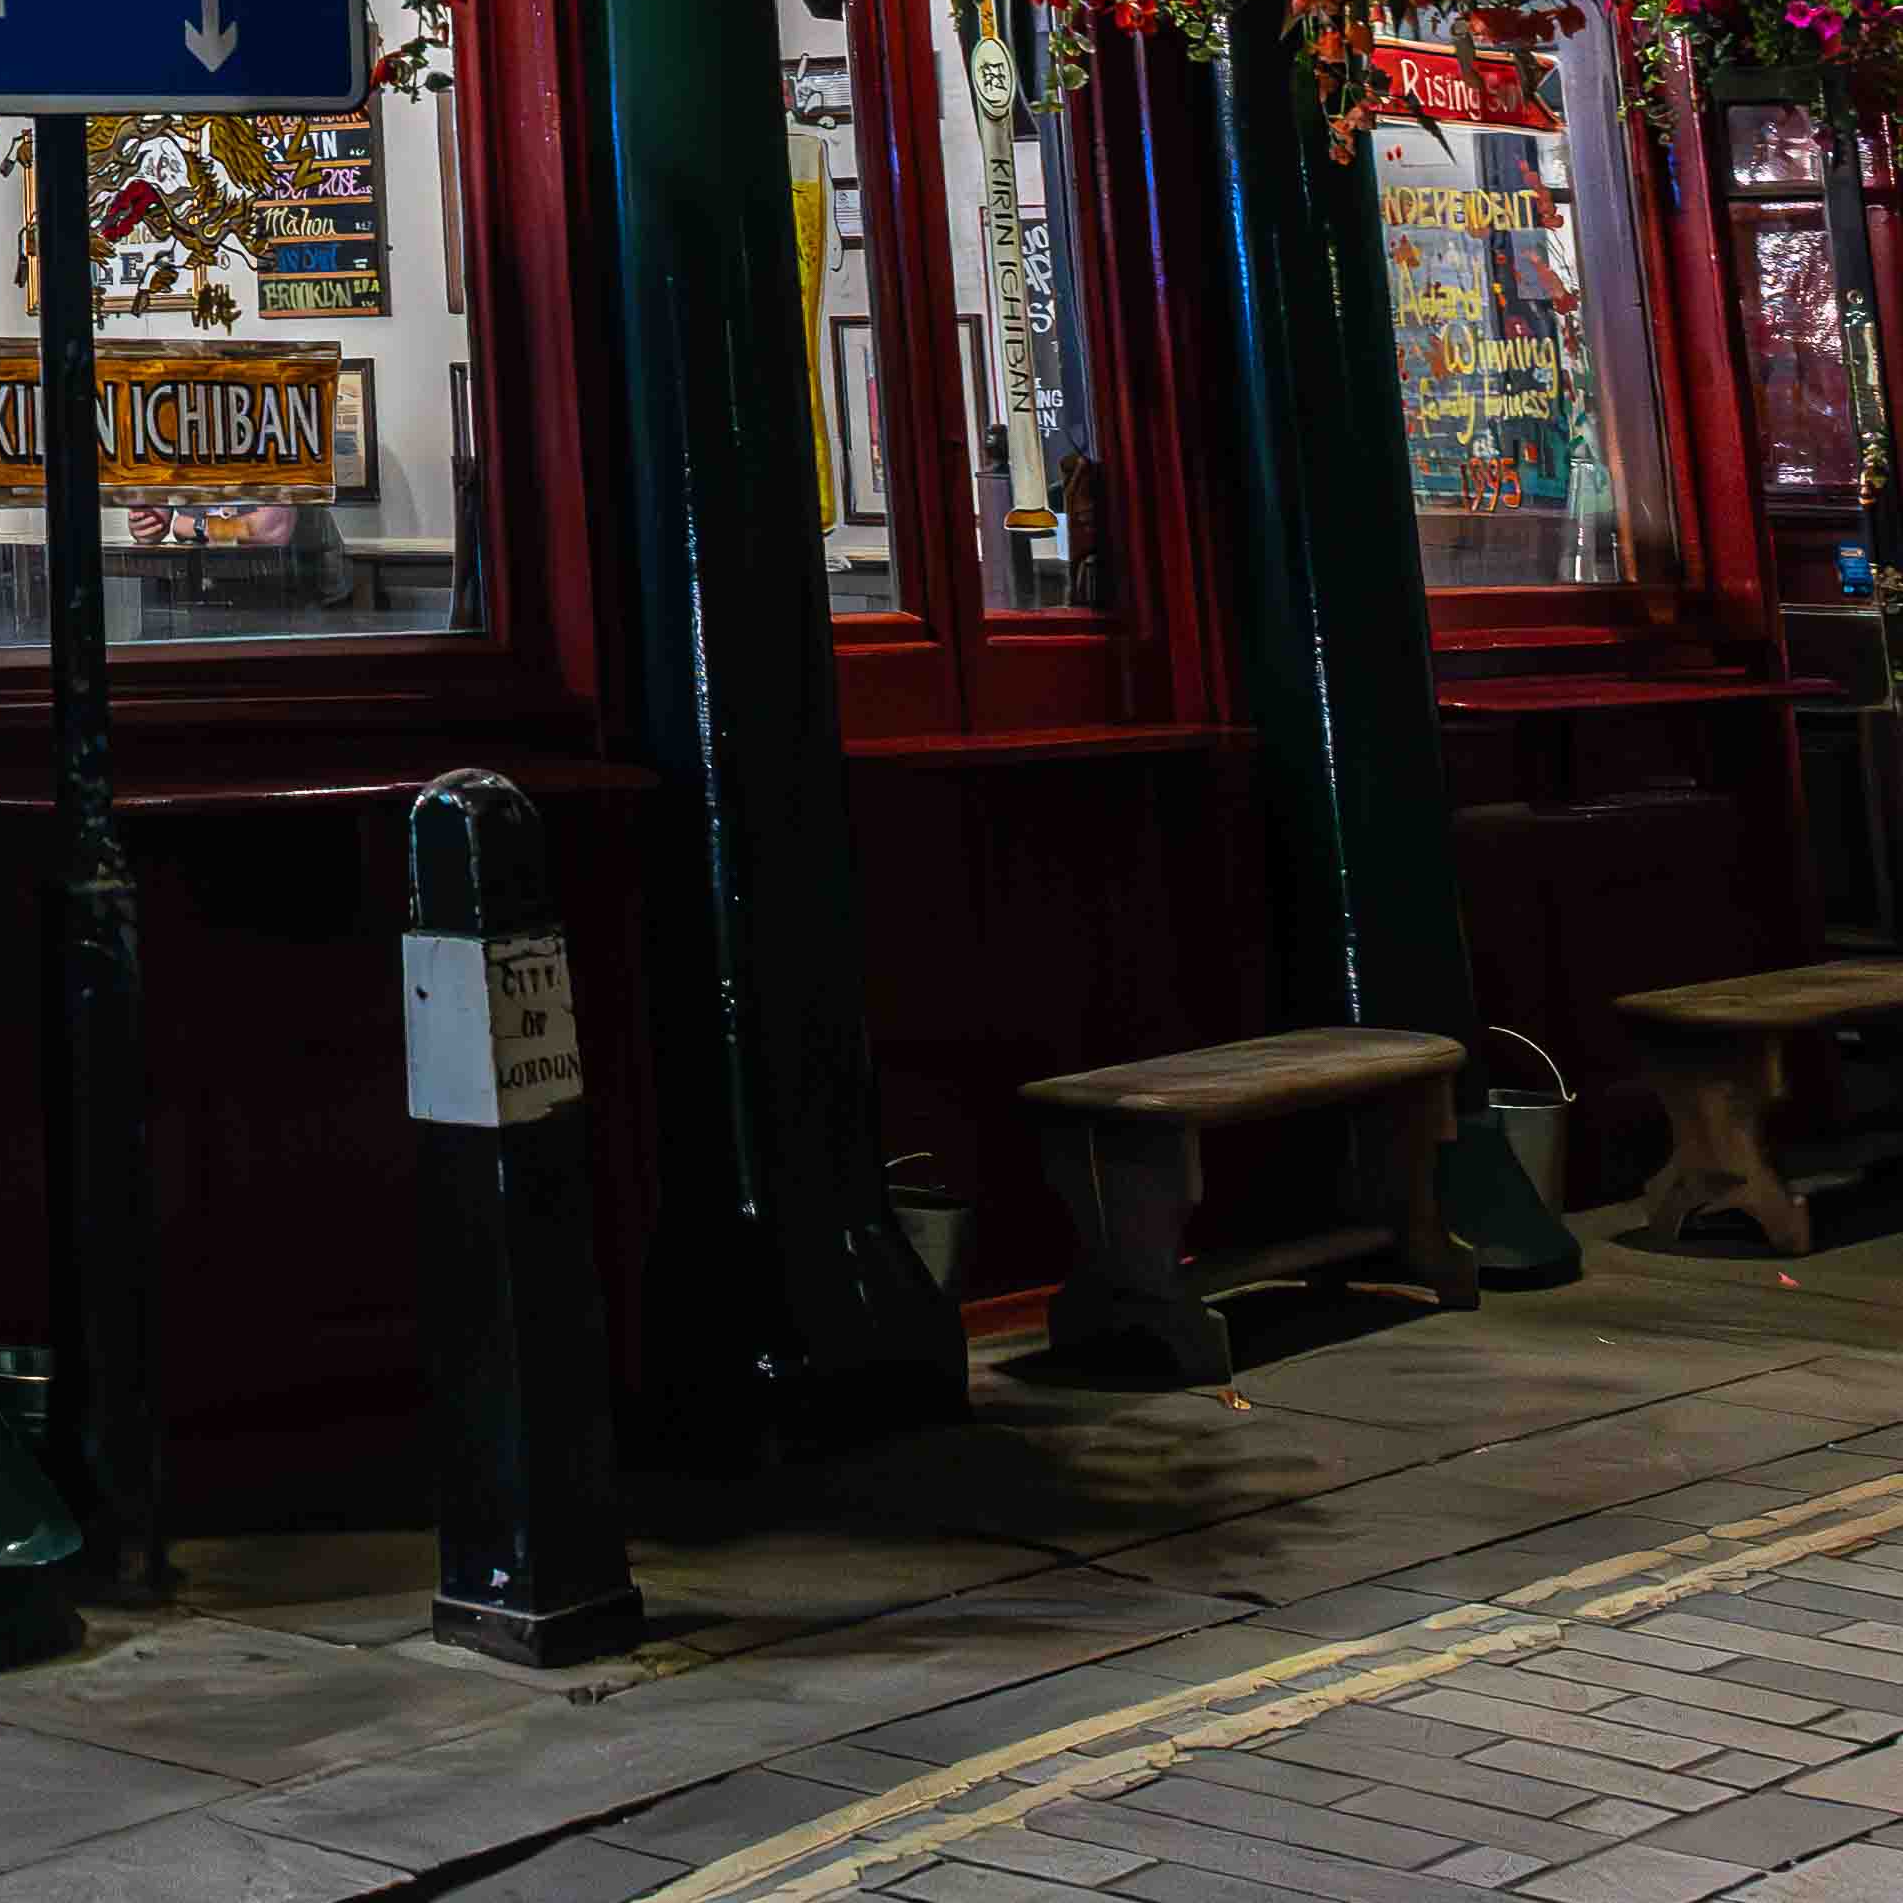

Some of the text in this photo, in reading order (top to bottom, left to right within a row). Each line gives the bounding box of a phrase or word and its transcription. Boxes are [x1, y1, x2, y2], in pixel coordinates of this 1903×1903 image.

[1400, 58, 1482, 121] Rising
[263, 280, 353, 311] BROOKLYN
[991, 158, 1032, 414] KIRIN ICHIBAN
[1442, 322, 1559, 399] Winning
[133, 382, 322, 463] ICHIBAN
[1459, 455, 1522, 512] 1995
